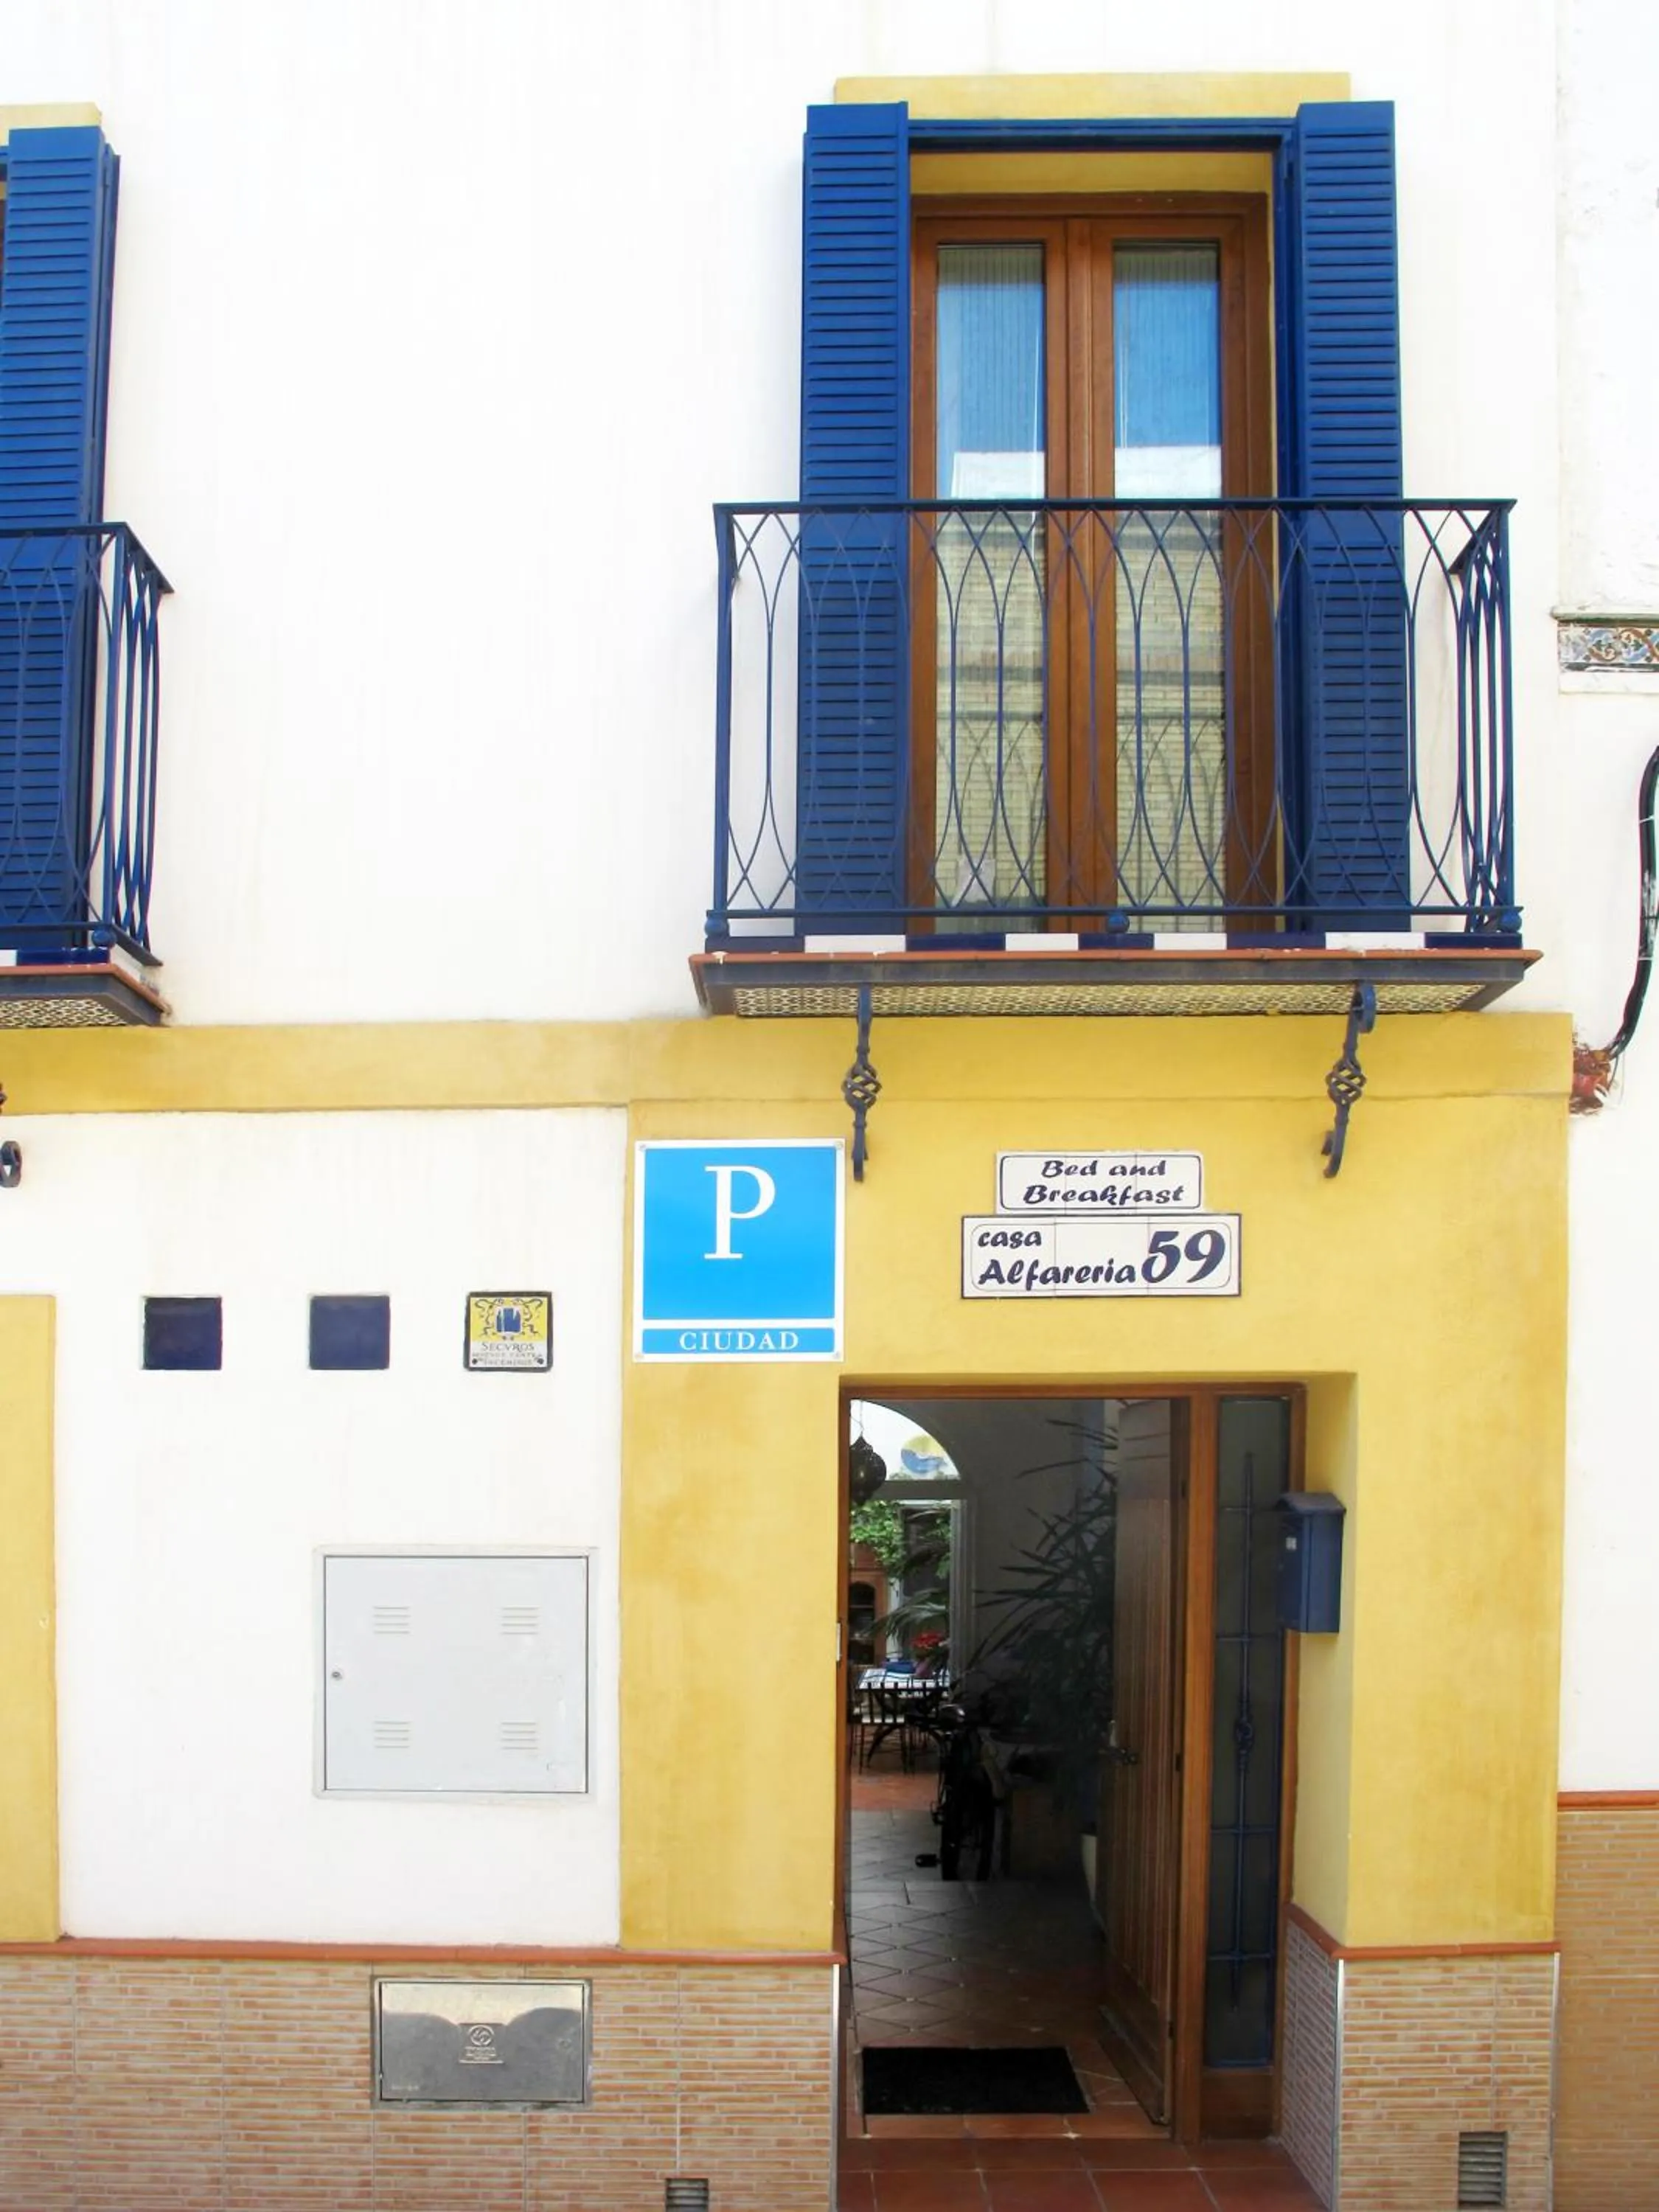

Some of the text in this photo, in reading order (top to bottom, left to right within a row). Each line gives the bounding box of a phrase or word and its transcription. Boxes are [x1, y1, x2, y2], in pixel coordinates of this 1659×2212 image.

[1042, 1160, 1166, 1178] Bed and
[1023, 1184, 1184, 1205] Breakfast
[703, 1165, 776, 1259] P
[977, 1230, 1043, 1249] casa
[978, 1229, 1226, 1290] Alfareria 59
[679, 1332, 799, 1351] CIUDAD
